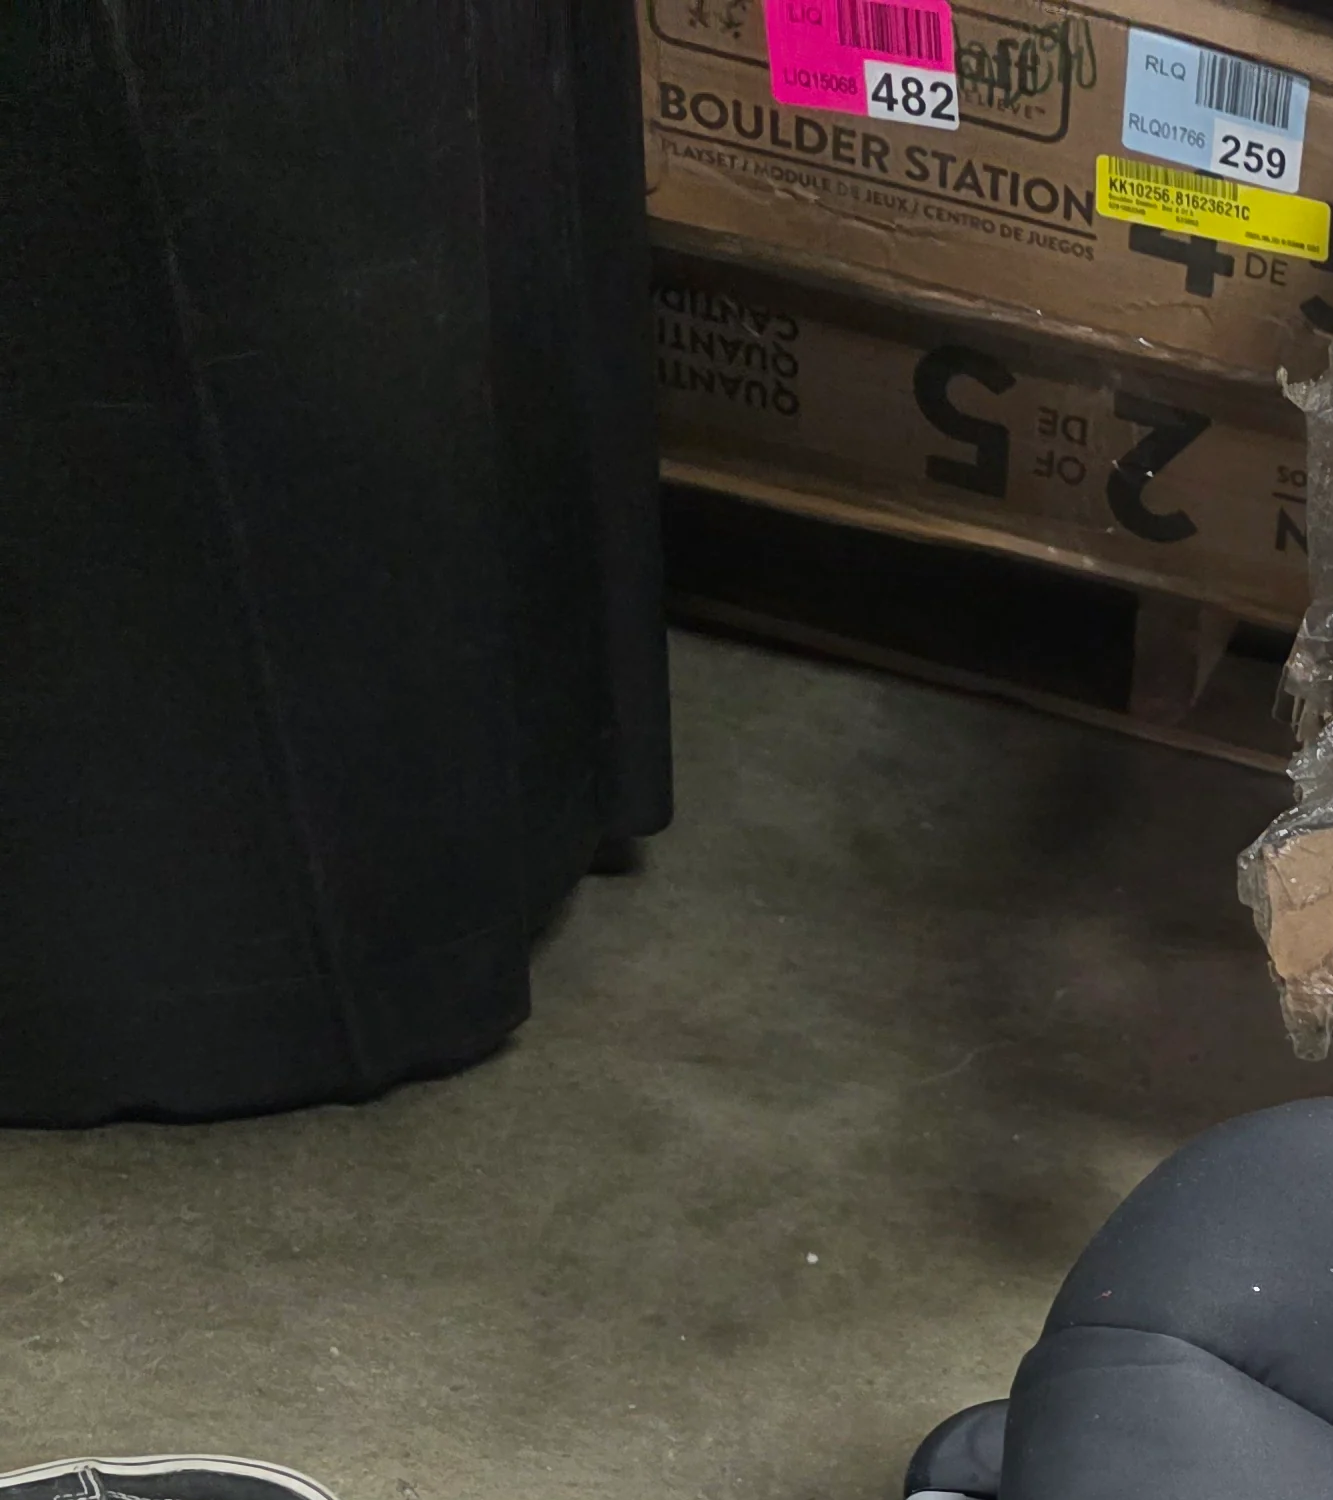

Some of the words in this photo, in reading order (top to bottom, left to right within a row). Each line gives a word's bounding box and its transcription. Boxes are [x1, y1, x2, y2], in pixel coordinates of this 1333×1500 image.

[1144, 54, 1187, 82] RLQ
[871, 72, 956, 123] 482
[659, 81, 890, 173] BOULDER
[905, 145, 1095, 227] STATION
[1128, 112, 1205, 150] RLQ01766
[1219, 134, 1286, 180] 259
[661, 137, 737, 169] PLAYSET
[754, 161, 831, 193] MODULE
[837, 183, 860, 199] DE
[863, 188, 906, 211] JEUX
[923, 205, 996, 233] CENTRO
[1000, 223, 1024, 242] DE
[1027, 230, 1095, 261] JUEGOS
[1109, 176, 1250, 222] KK10256.81623621C
[1244, 252, 1289, 287] DE
[655, 321, 800, 380] QUANTI
[656, 358, 800, 418] QUANTI
[913, 343, 1017, 502] 5
[1037, 406, 1090, 445] DE
[1034, 455, 1087, 487] OF
[1106, 391, 1213, 544] 2
